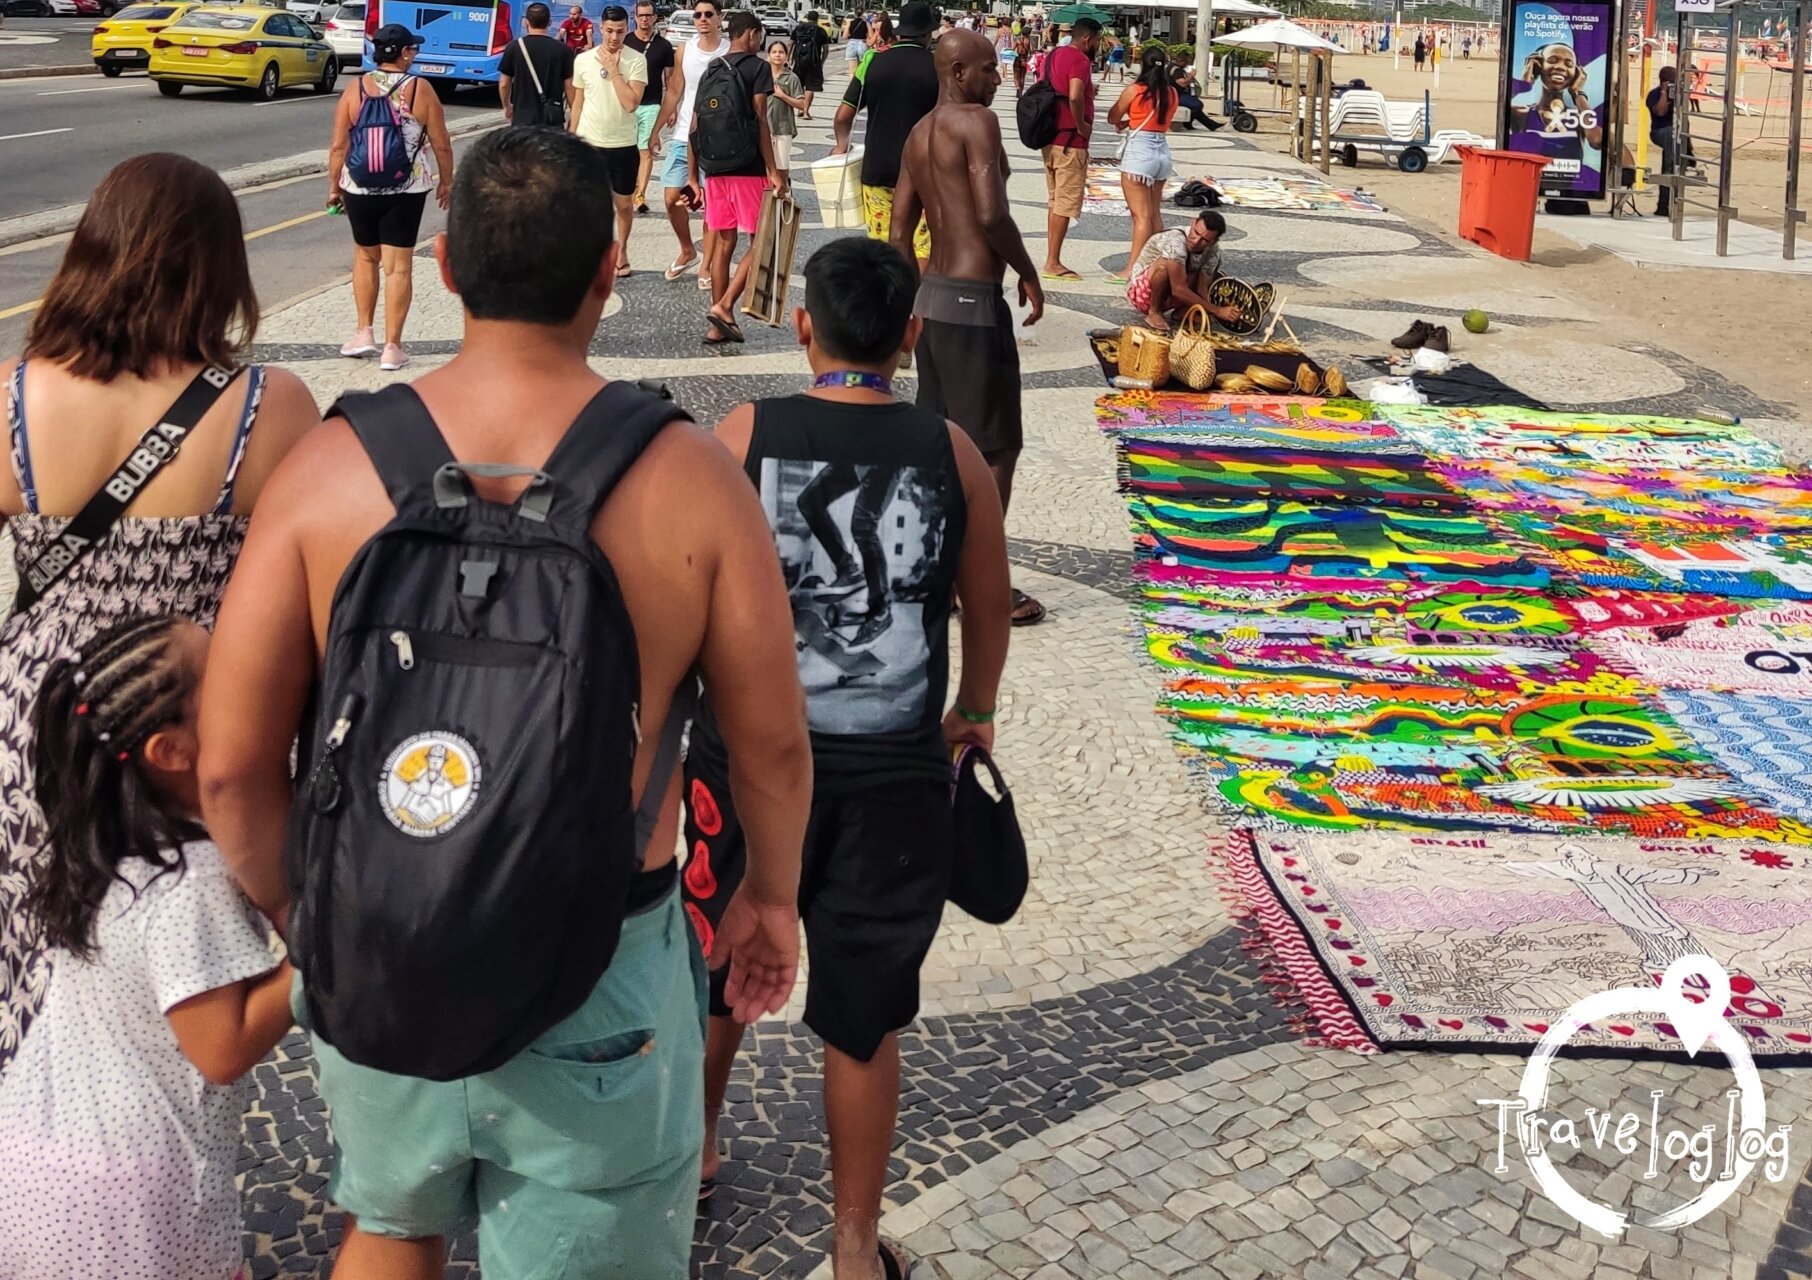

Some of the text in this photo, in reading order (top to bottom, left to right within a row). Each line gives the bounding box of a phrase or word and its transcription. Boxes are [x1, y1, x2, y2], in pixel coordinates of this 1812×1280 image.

[468, 11, 489, 23] 9001
[1524, 11, 1599, 23] Ouça agora nossas
[1524, 20, 1594, 31] playlists de verão
[1564, 108, 1598, 129] 5G
[104, 422, 187, 504] BUBBA
[27, 533, 91, 594] BUBBA
